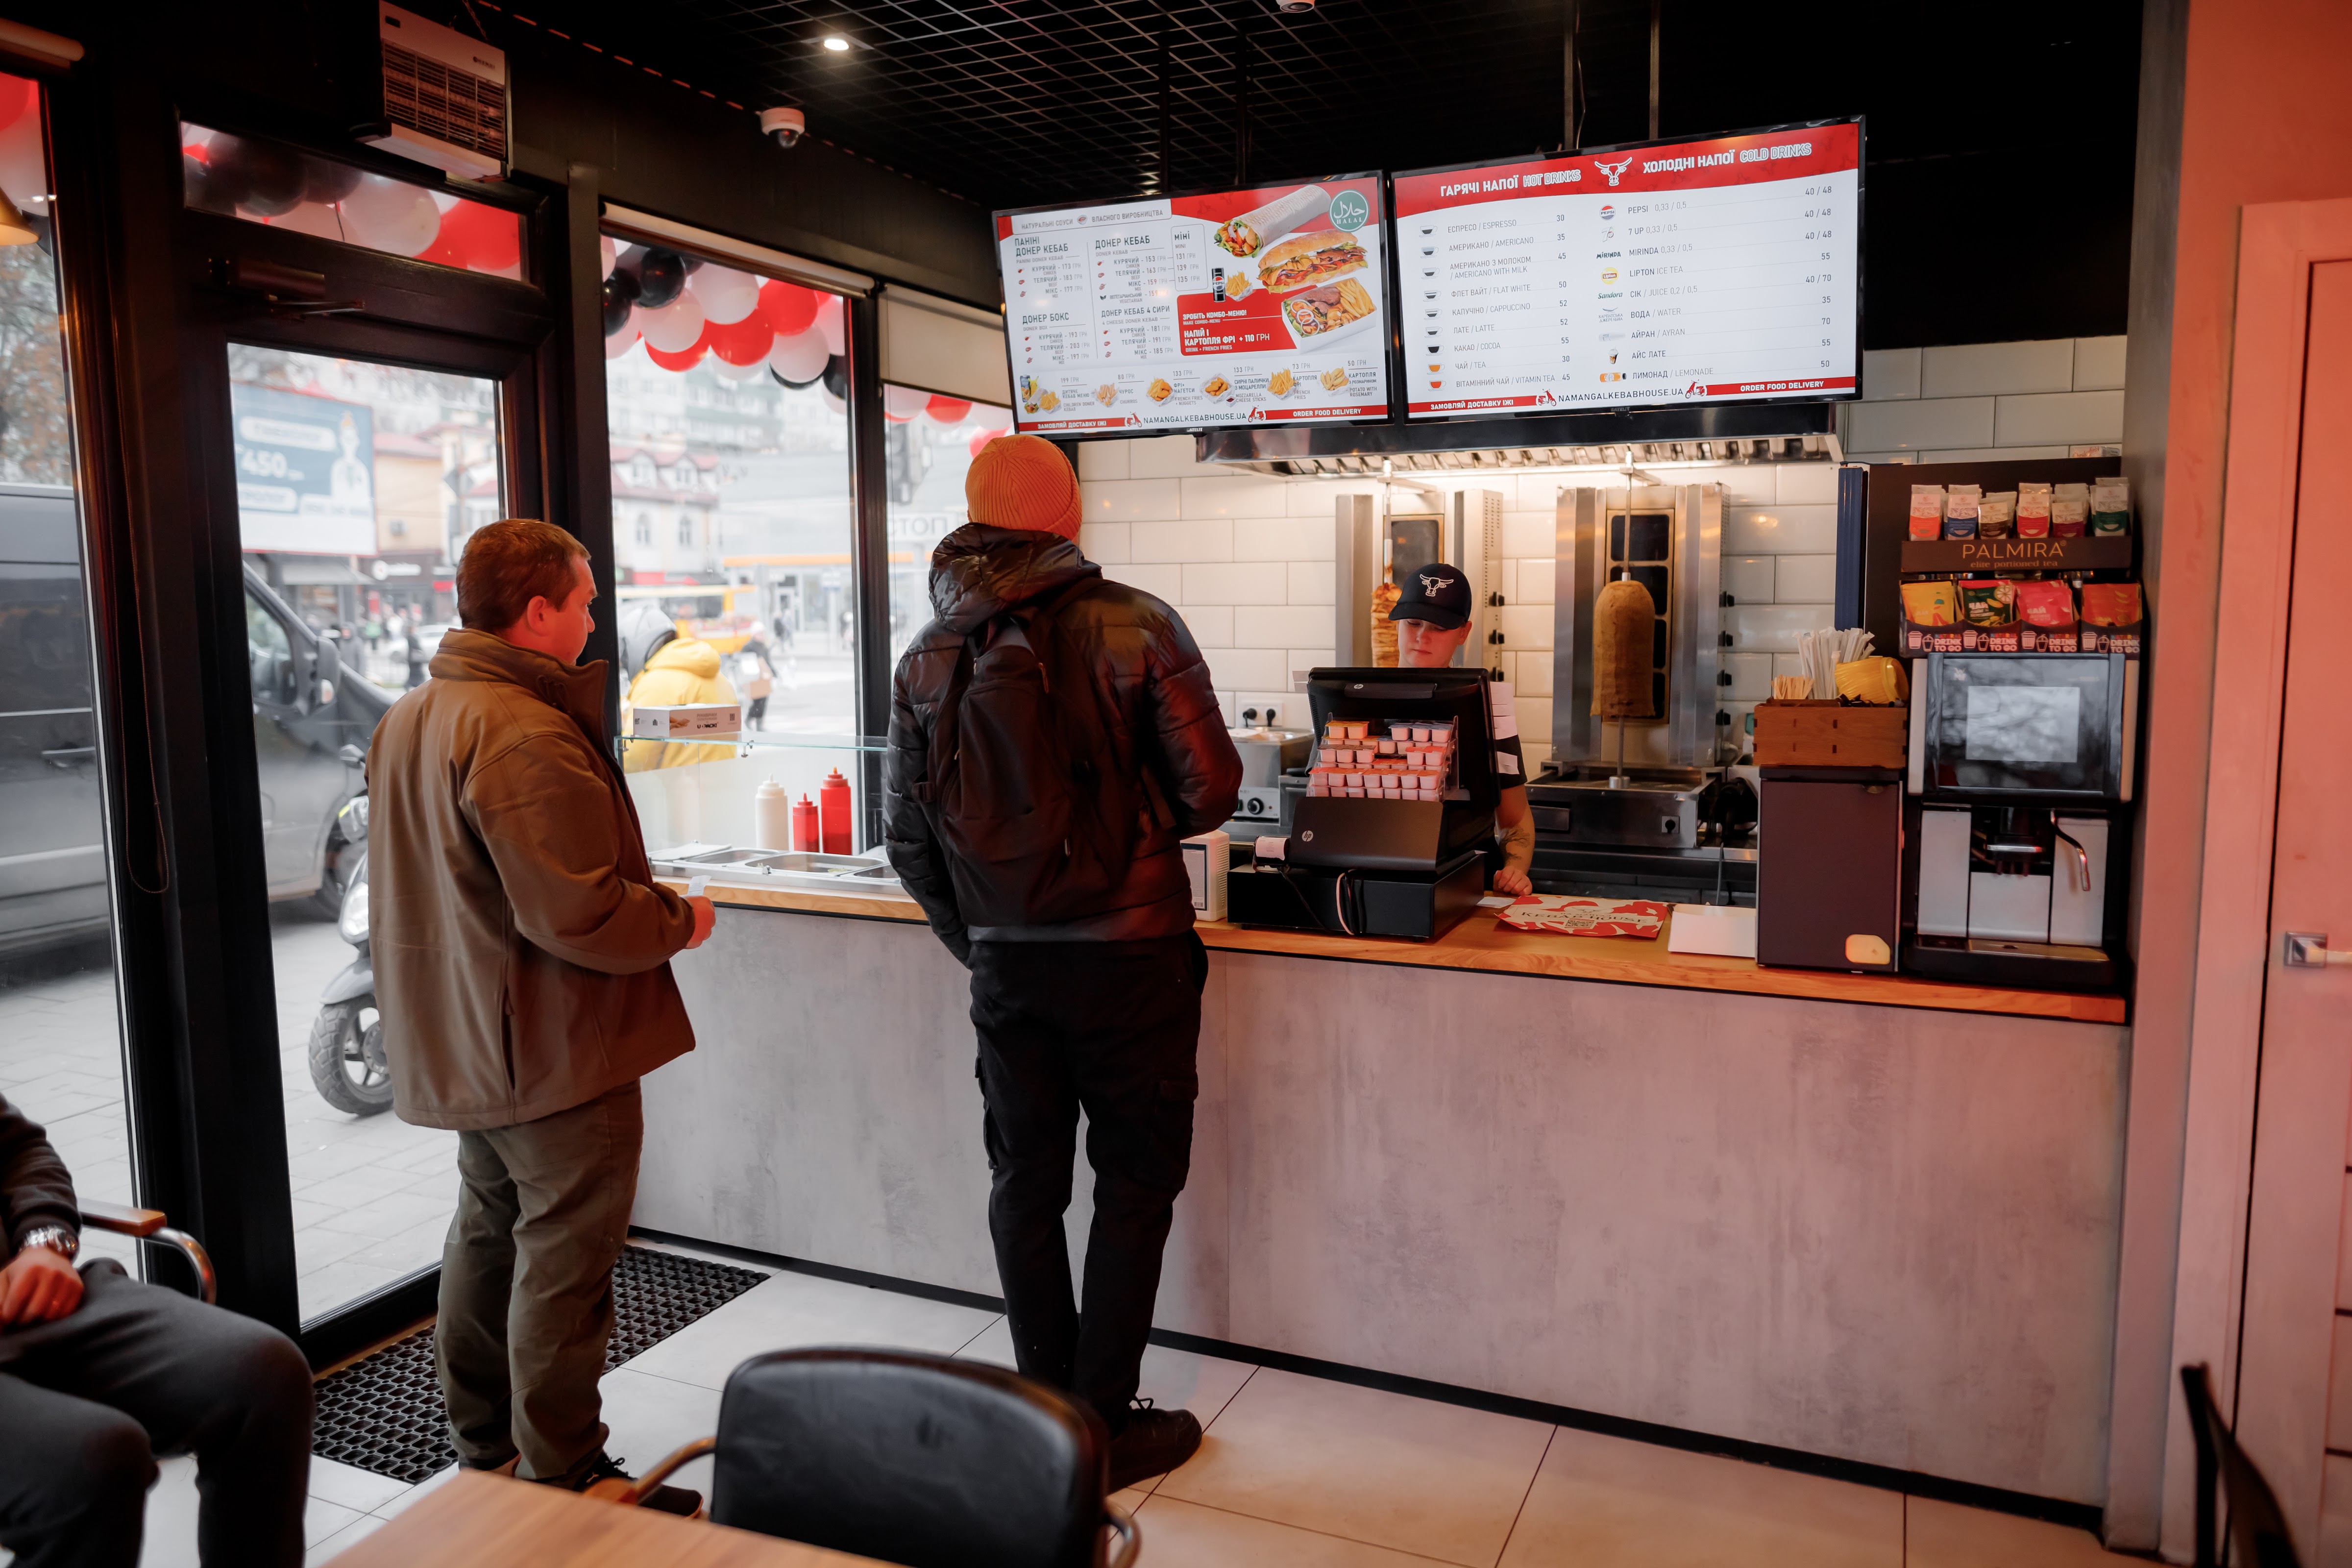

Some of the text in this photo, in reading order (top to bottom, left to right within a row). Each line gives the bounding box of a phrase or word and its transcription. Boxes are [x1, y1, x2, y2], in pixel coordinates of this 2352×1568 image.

[1643, 143, 1812, 173] ХОЛОДНІ НАПОЇ COLD DRINKS
[1441, 170, 1581, 196] ГАРЯЧІ НАПОЇ HOT DRINKS
[1122, 210, 1163, 219] ВИРОБНИЦТВА
[1628, 205, 1648, 214] PEPSI
[1448, 224, 1476, 233] ЕСПРЕСО
[1483, 220, 1516, 229] ESPRESSO
[1015, 237, 1039, 246] ПАНІНІ
[1096, 236, 1150, 249] ДОНЕР КЕБАБ
[1449, 242, 1489, 251] АМЕРИКАНО
[1495, 237, 1533, 246] AMERICANO
[1016, 244, 1068, 257] ДОНЕР КЕБАБ
[1630, 247, 1658, 256] MIRINDA
[1450, 260, 1490, 270] АМЕРИКАНО
[1498, 256, 1531, 265] МОЛОКОМ
[1471, 287, 1487, 295] ВАЙТ
[1102, 309, 1122, 318] ДОНЕР
[1452, 307, 1484, 316] КАПУЧІНО
[1491, 303, 1530, 312] CAPPUCCINO
[1023, 313, 1069, 325] ДОНЕР БОКС
[1184, 328, 1204, 337] НАПІЙ
[1632, 330, 1654, 339] АЙРАН
[1185, 337, 1221, 346] КАРТОПЛЯ
[1676, 368, 1713, 376] LEMONADE
[1456, 377, 1494, 387] ВІТАМІННИЙ
[1740, 384, 1765, 392] ORDER
[1788, 381, 1824, 389] DELIVERY
[1430, 401, 1466, 410] ЗАМОВЛЯЙ
[1467, 400, 1501, 409] ДОСТАВКУ
[1962, 543, 2064, 559] PALMIRA
